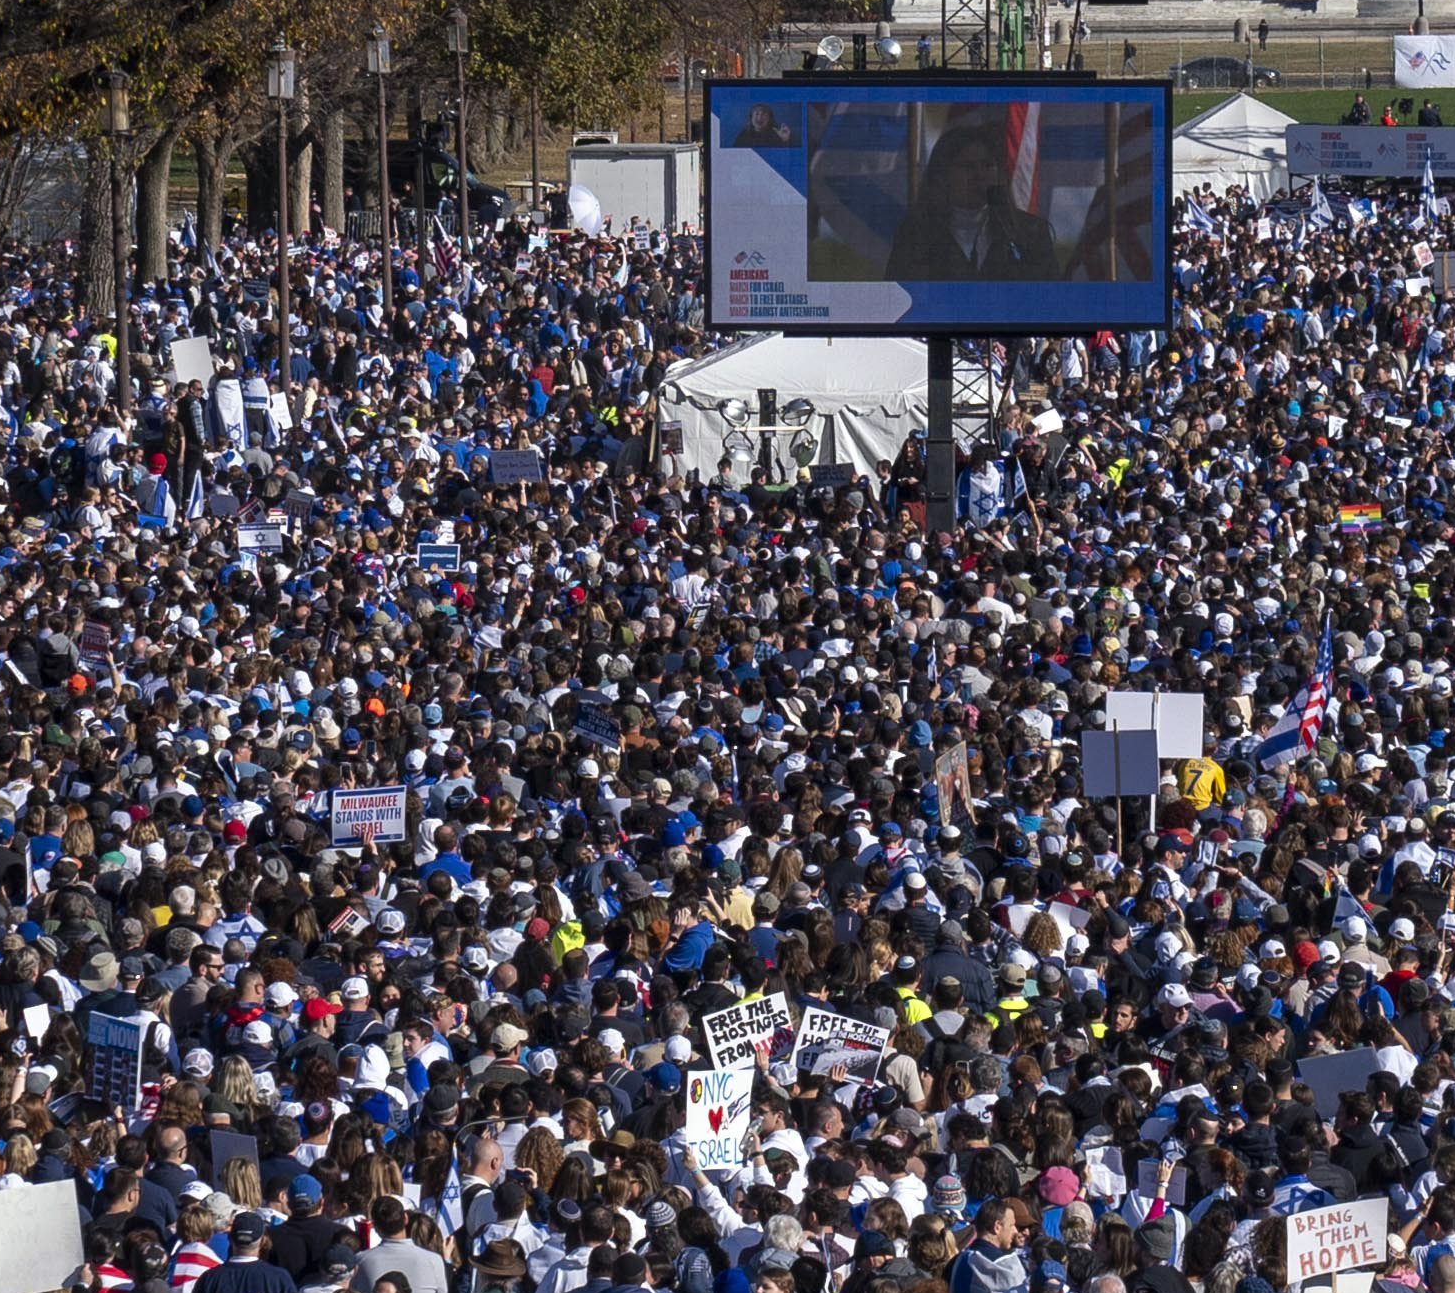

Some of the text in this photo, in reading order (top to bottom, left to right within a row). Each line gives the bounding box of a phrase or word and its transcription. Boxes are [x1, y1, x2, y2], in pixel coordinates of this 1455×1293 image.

[1185, 769, 1203, 795] 7
[335, 806, 401, 824] STANDS WITH
[340, 795, 398, 810] MILWAUKEE
[351, 821, 384, 836] ISRAEL
[707, 998, 774, 1034] FREE THE
[713, 1010, 789, 1047] HOSTAGES
[717, 1039, 756, 1069] FROM
[701, 1072, 734, 1105] NYC
[1295, 1209, 1353, 1235] BRING
[1315, 1221, 1369, 1247] THEM
[1298, 1240, 1377, 1276] HOME
